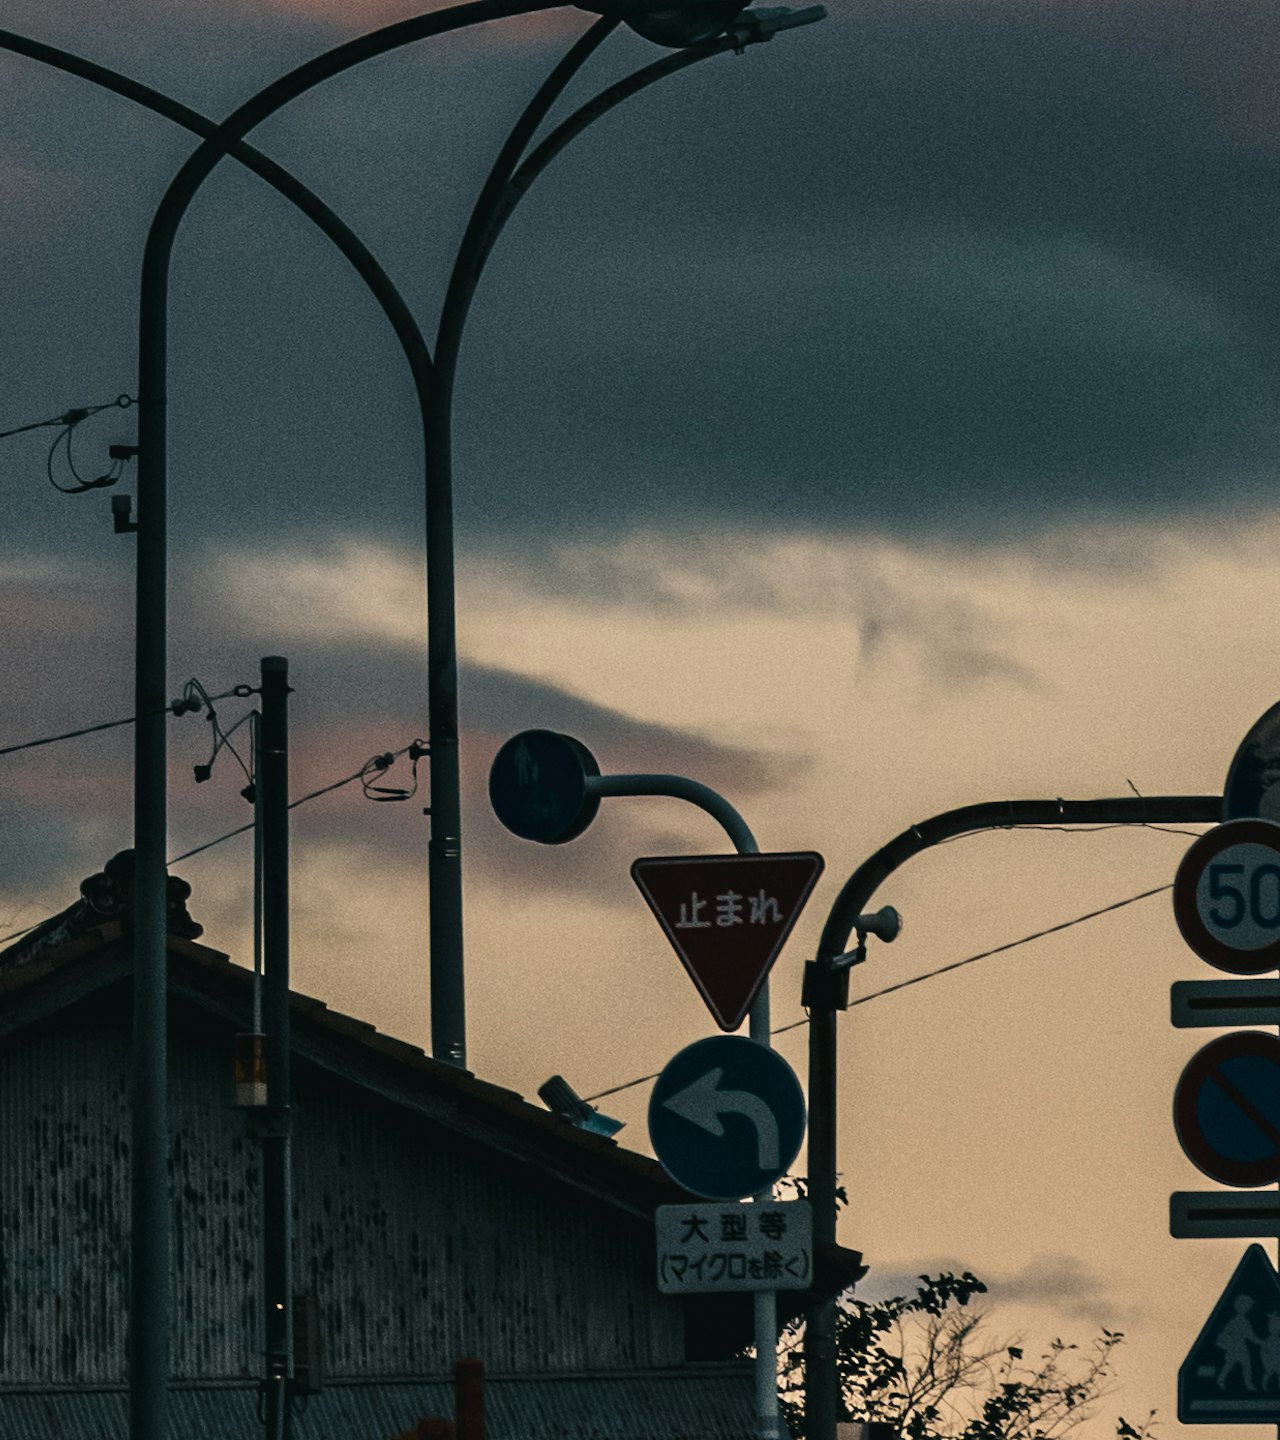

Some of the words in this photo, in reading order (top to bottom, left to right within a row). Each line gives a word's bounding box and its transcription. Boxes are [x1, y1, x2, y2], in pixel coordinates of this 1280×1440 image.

[675, 889, 783, 928] 止まれ
[1210, 864, 1280, 928] 50
[681, 1211, 787, 1243] 大型等
[661, 1248, 809, 1284] (マイクロを除く)
